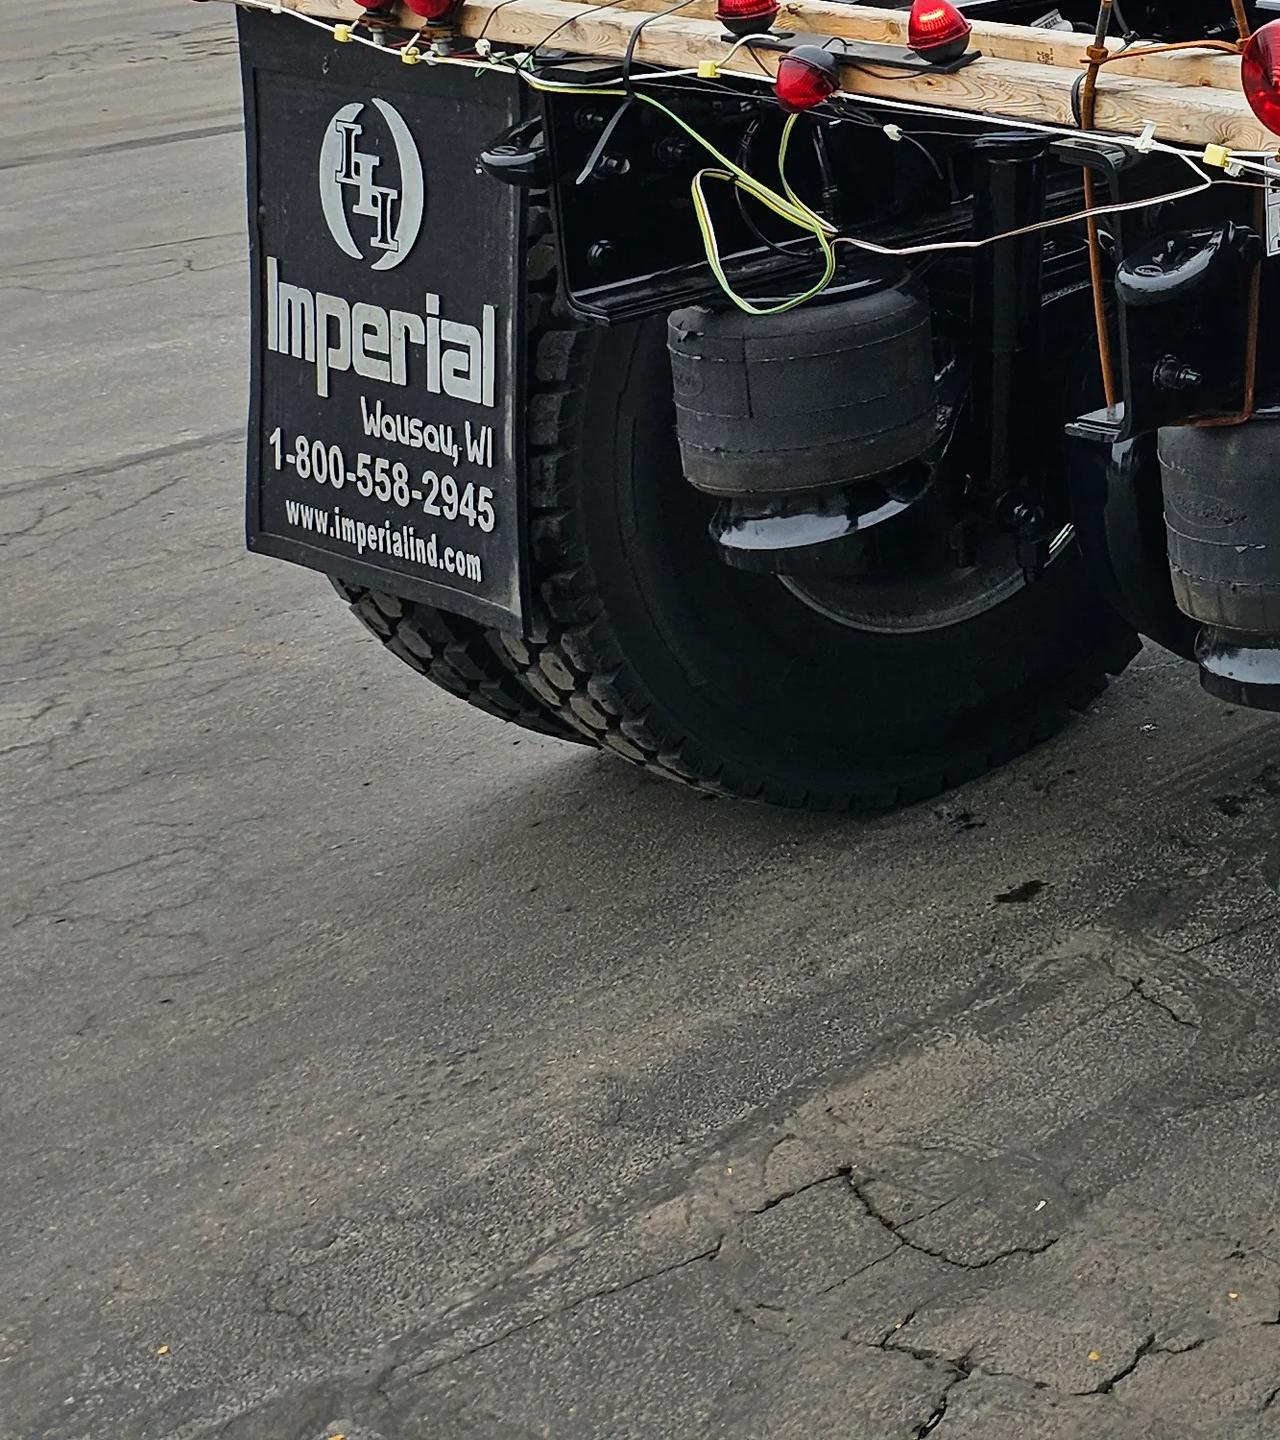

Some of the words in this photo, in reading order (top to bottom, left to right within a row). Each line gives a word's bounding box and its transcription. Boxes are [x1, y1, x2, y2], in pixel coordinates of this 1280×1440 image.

[266, 256, 496, 408] Imperial
[268, 426, 496, 535] 1-800-558-2945
[360, 396, 459, 468] Wausau,
[464, 419, 494, 469] WI
[285, 496, 483, 583] www.imperialind.com
